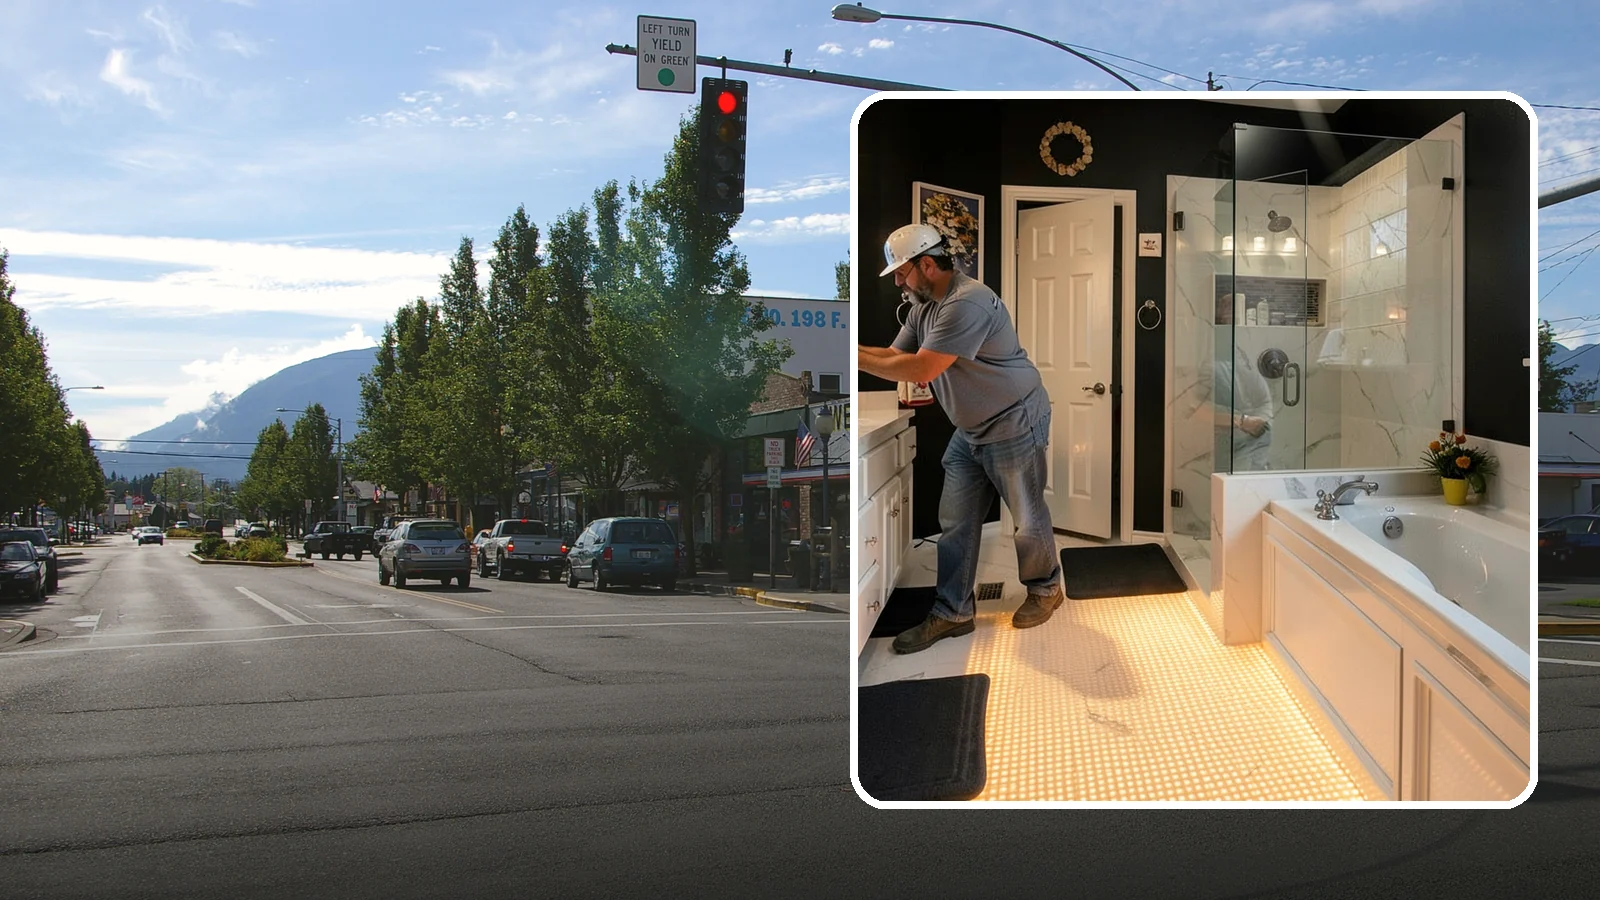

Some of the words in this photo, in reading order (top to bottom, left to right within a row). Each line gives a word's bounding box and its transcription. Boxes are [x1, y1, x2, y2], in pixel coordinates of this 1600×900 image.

[643, 23, 663, 34] LEFT
[668, 25, 690, 36] TURN
[652, 38, 682, 51] YIELD
[644, 53, 656, 63] ON
[661, 55, 689, 66] GREEN
[791, 309, 826, 328] 198
[831, 311, 846, 329] F.
